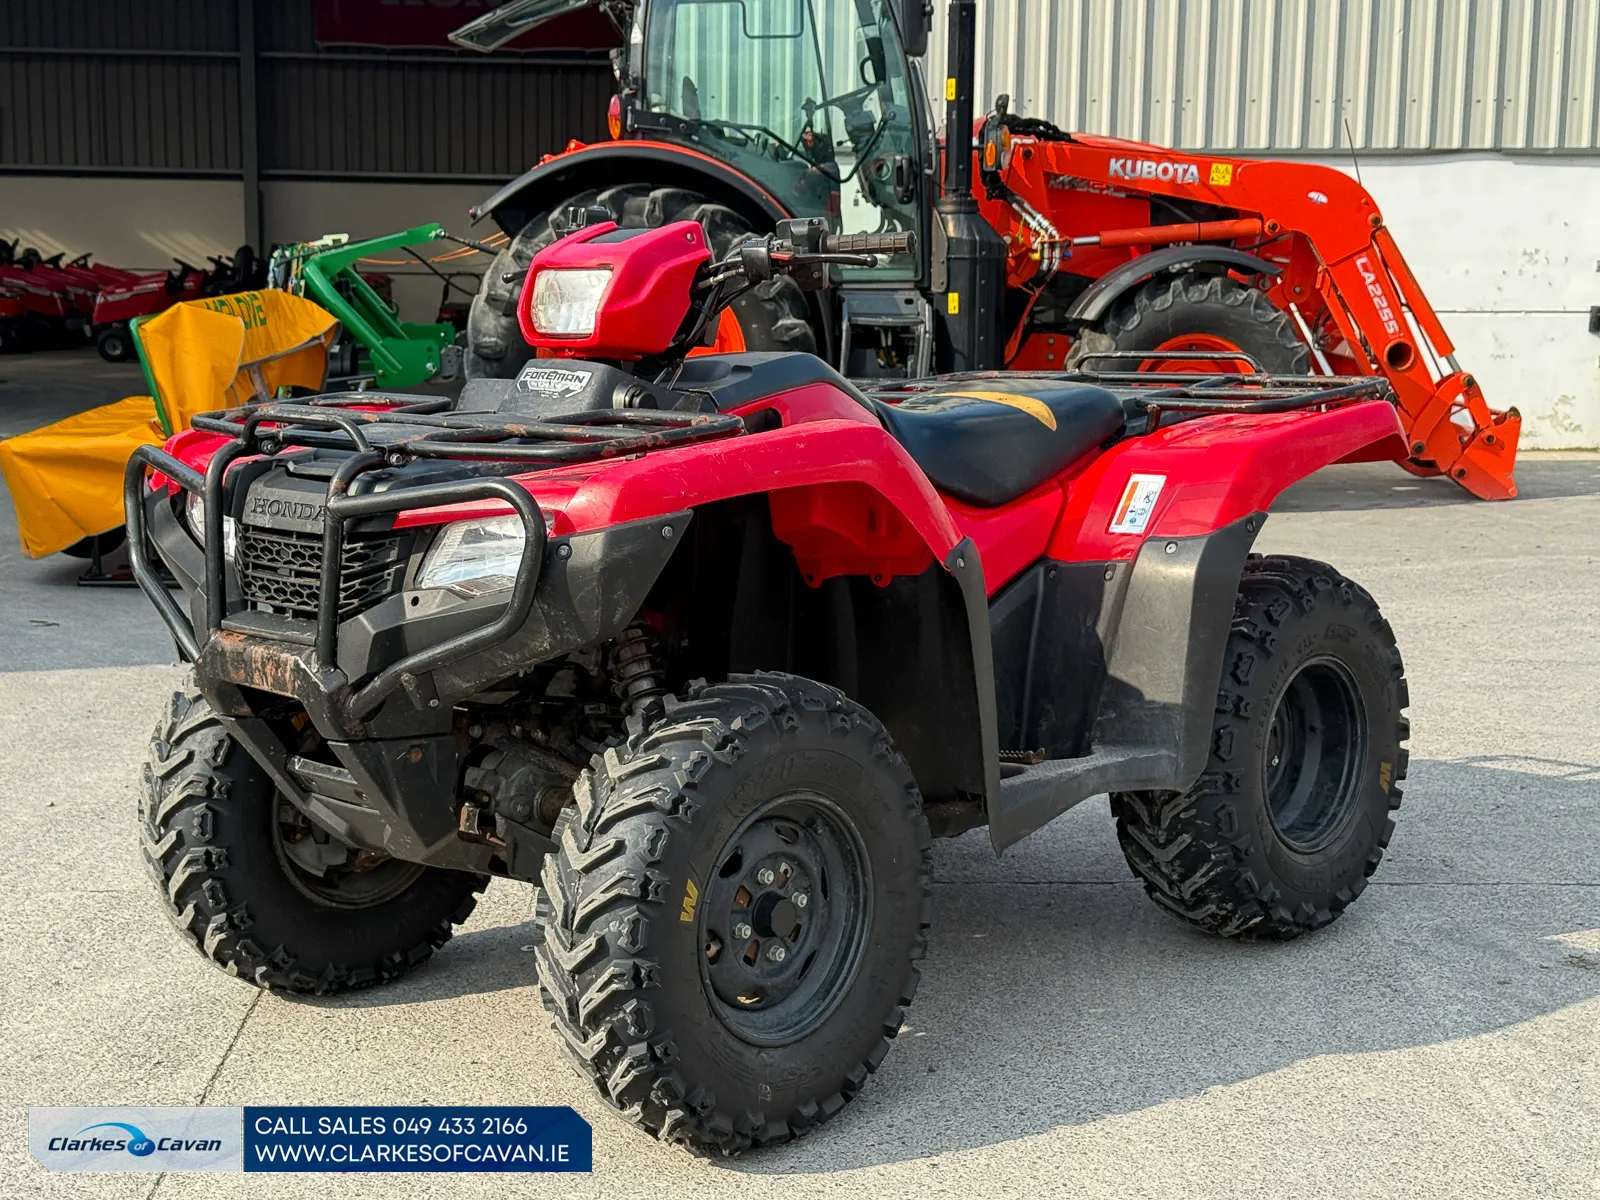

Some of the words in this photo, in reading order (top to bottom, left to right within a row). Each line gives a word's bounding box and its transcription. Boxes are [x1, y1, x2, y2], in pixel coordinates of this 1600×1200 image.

[1108, 157, 1200, 184] KUBOTA
[1355, 256, 1401, 335] LA2255
[522, 370, 586, 385] FOREMAN
